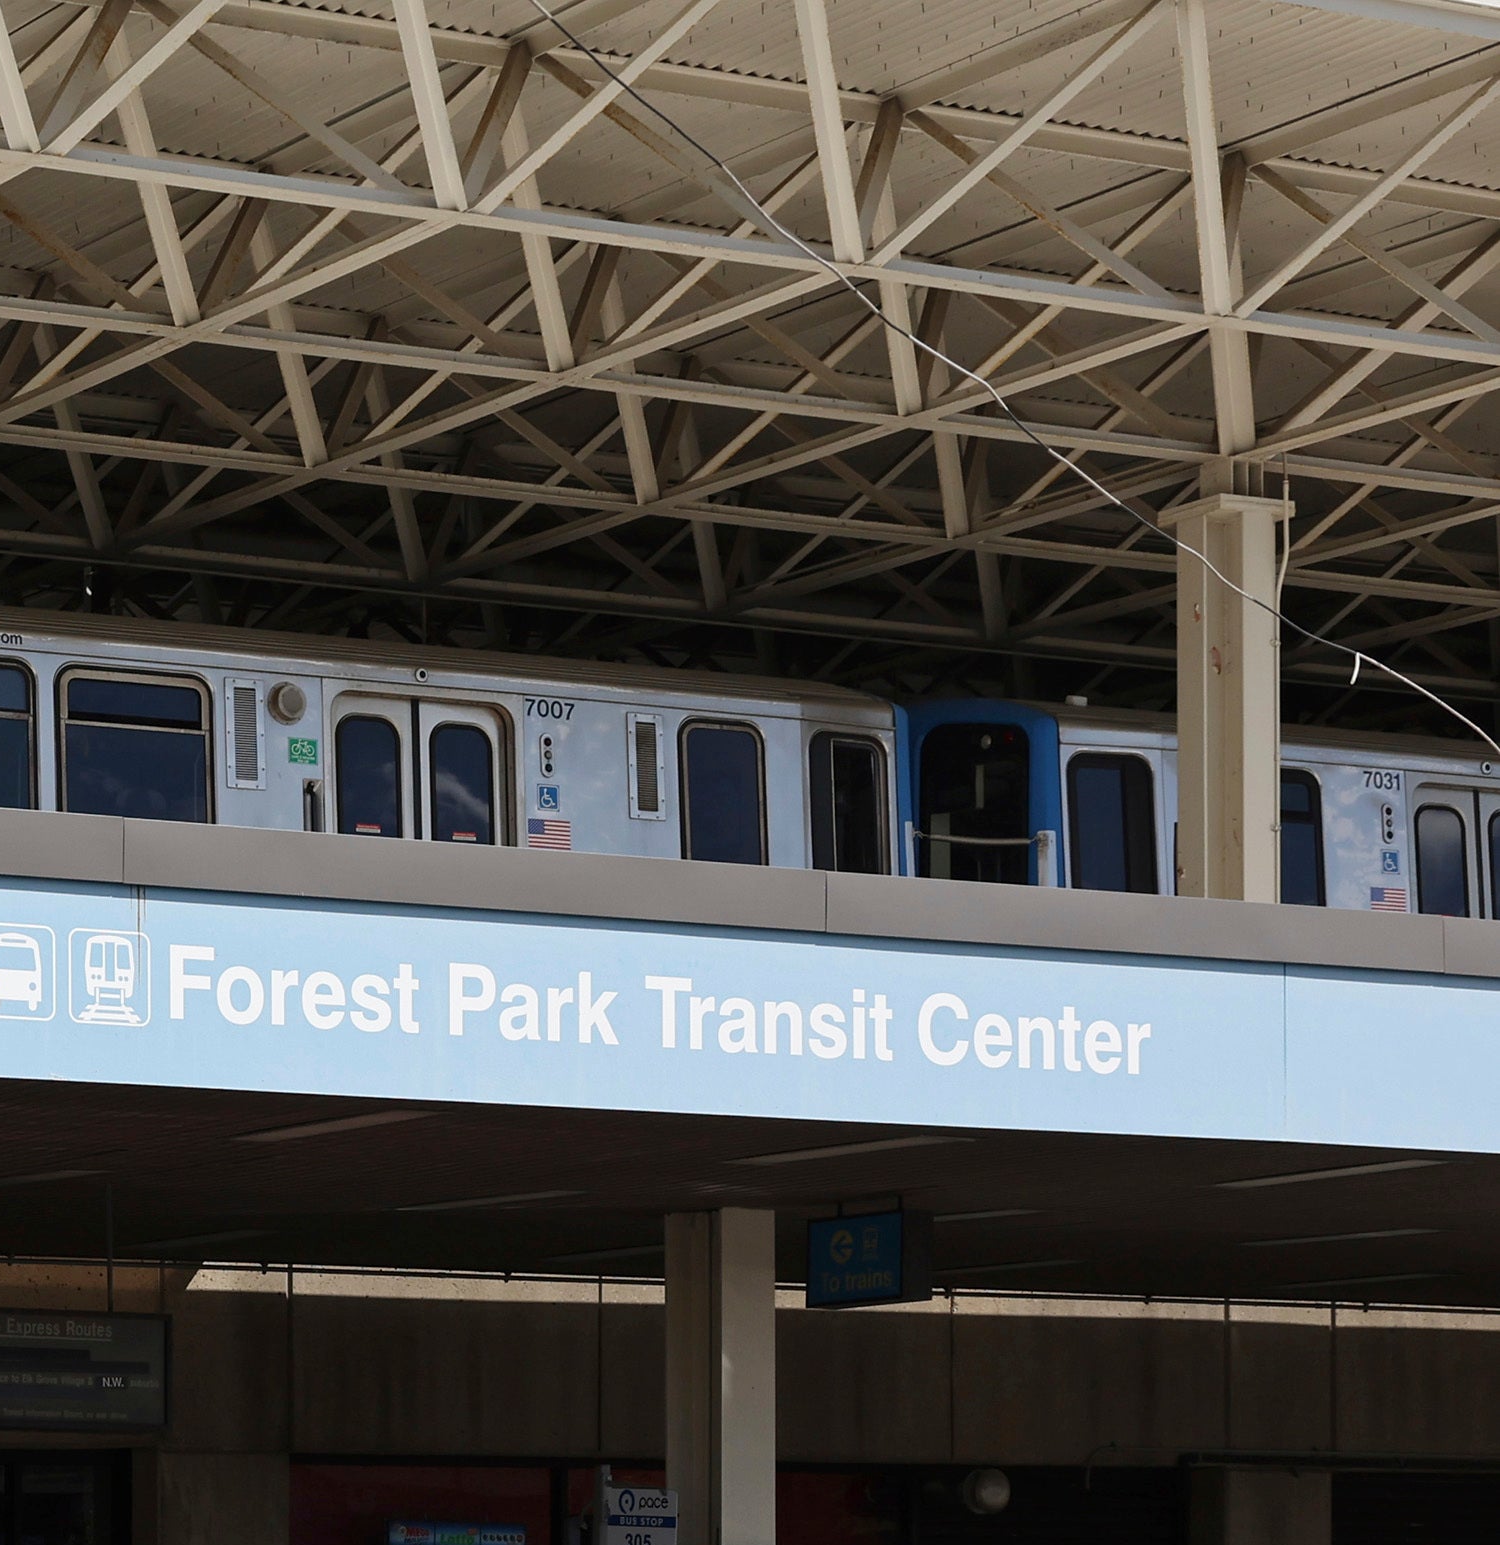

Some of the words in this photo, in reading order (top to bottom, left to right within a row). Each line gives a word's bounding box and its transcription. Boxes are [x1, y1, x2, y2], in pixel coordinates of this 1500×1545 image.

[525, 698, 575, 721] 7007
[1362, 770, 1402, 791] 7031
[169, 944, 420, 1034] Forest
[449, 963, 619, 1046] Park
[645, 974, 893, 1062] Transit
[917, 992, 1152, 1075] Center
[821, 1272, 840, 1293] To
[845, 1267, 892, 1292] trains
[6, 1318, 60, 1337] Express
[66, 1320, 113, 1338] Routes
[102, 1377, 124, 1388] N.W.
[639, 1497, 668, 1509] pace
[620, 1517, 637, 1525] BUS
[640, 1518, 664, 1526] STOP
